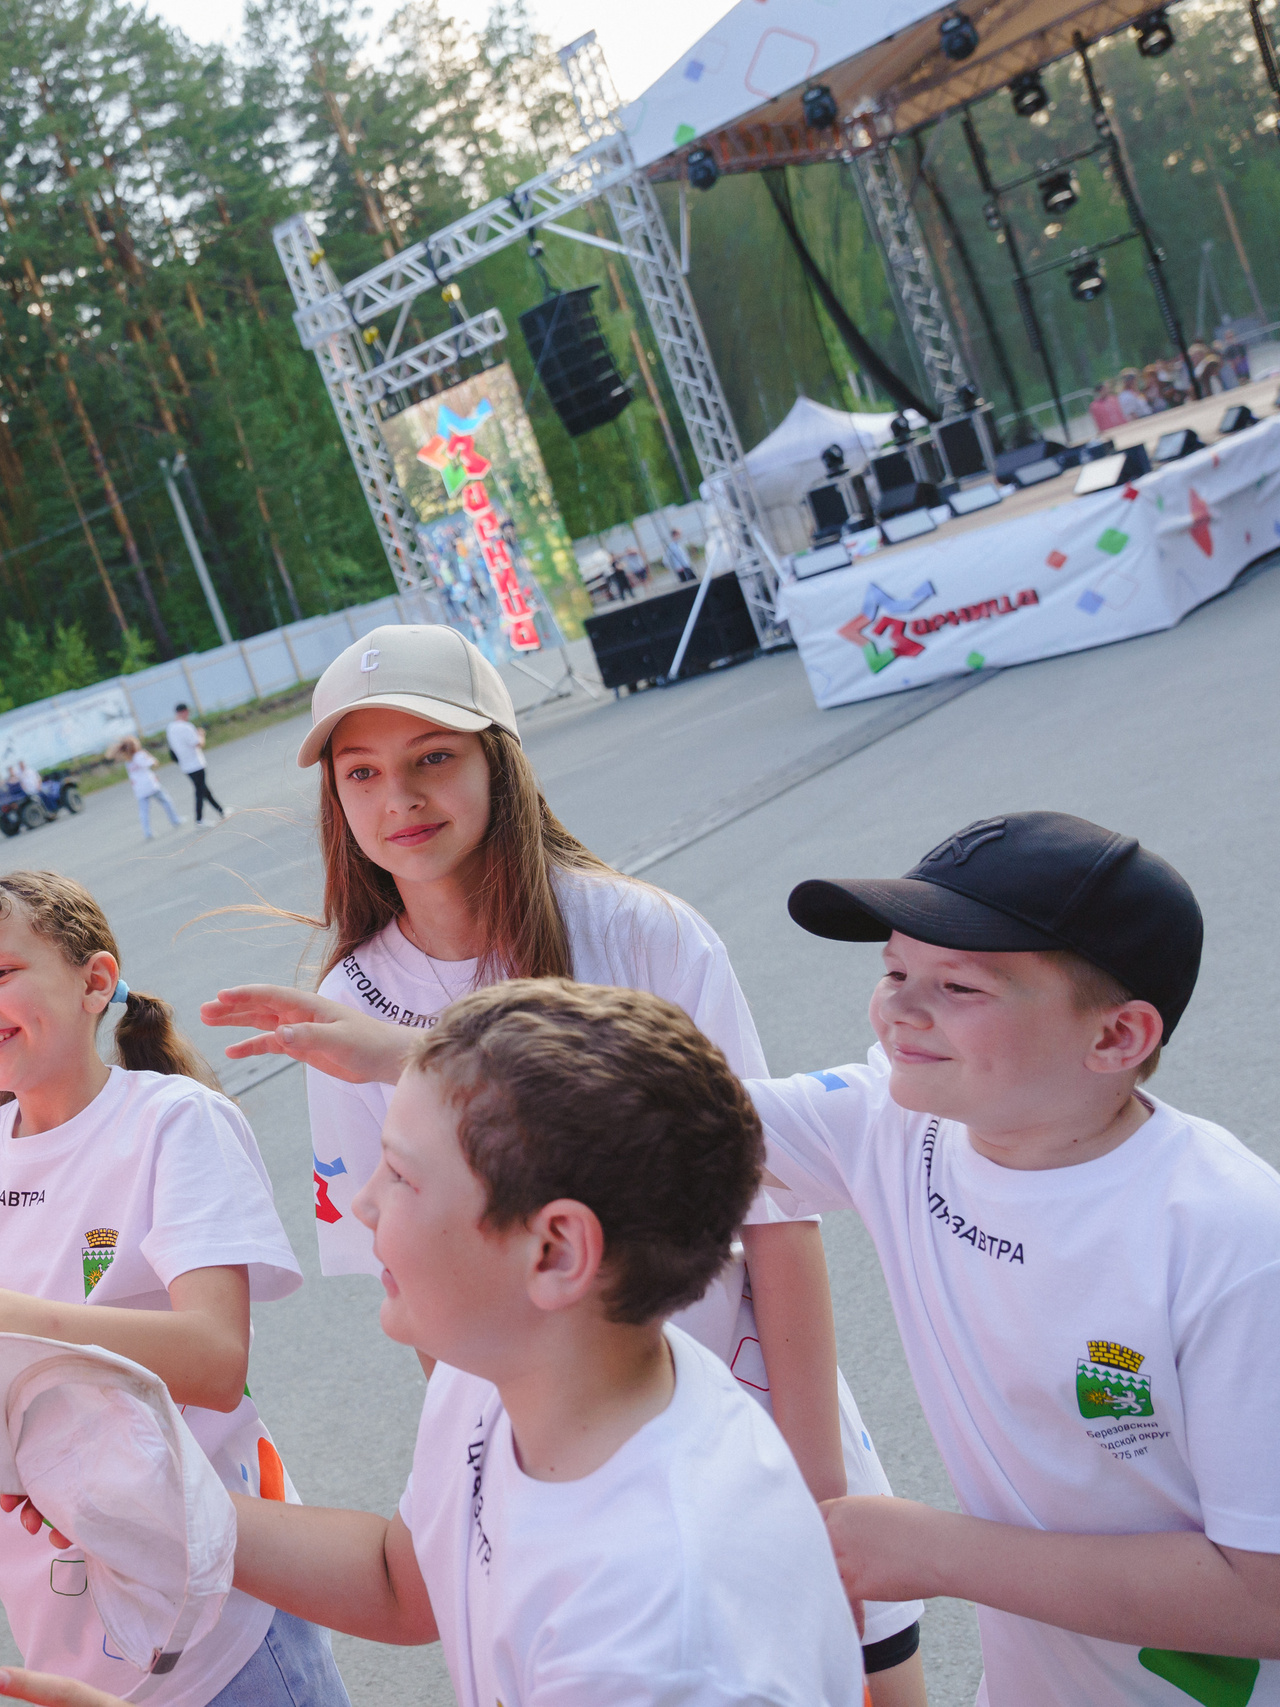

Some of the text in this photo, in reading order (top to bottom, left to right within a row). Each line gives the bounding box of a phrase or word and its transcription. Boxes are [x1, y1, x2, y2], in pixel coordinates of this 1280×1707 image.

[342, 955, 400, 1021] СЕГОДНЯ
[951, 1215, 1024, 1265] ЗАВТРА
[1086, 1422, 1159, 1440] Березовский
[1100, 1431, 1171, 1450] одской округ
[1133, 1446, 1149, 1458] лет
